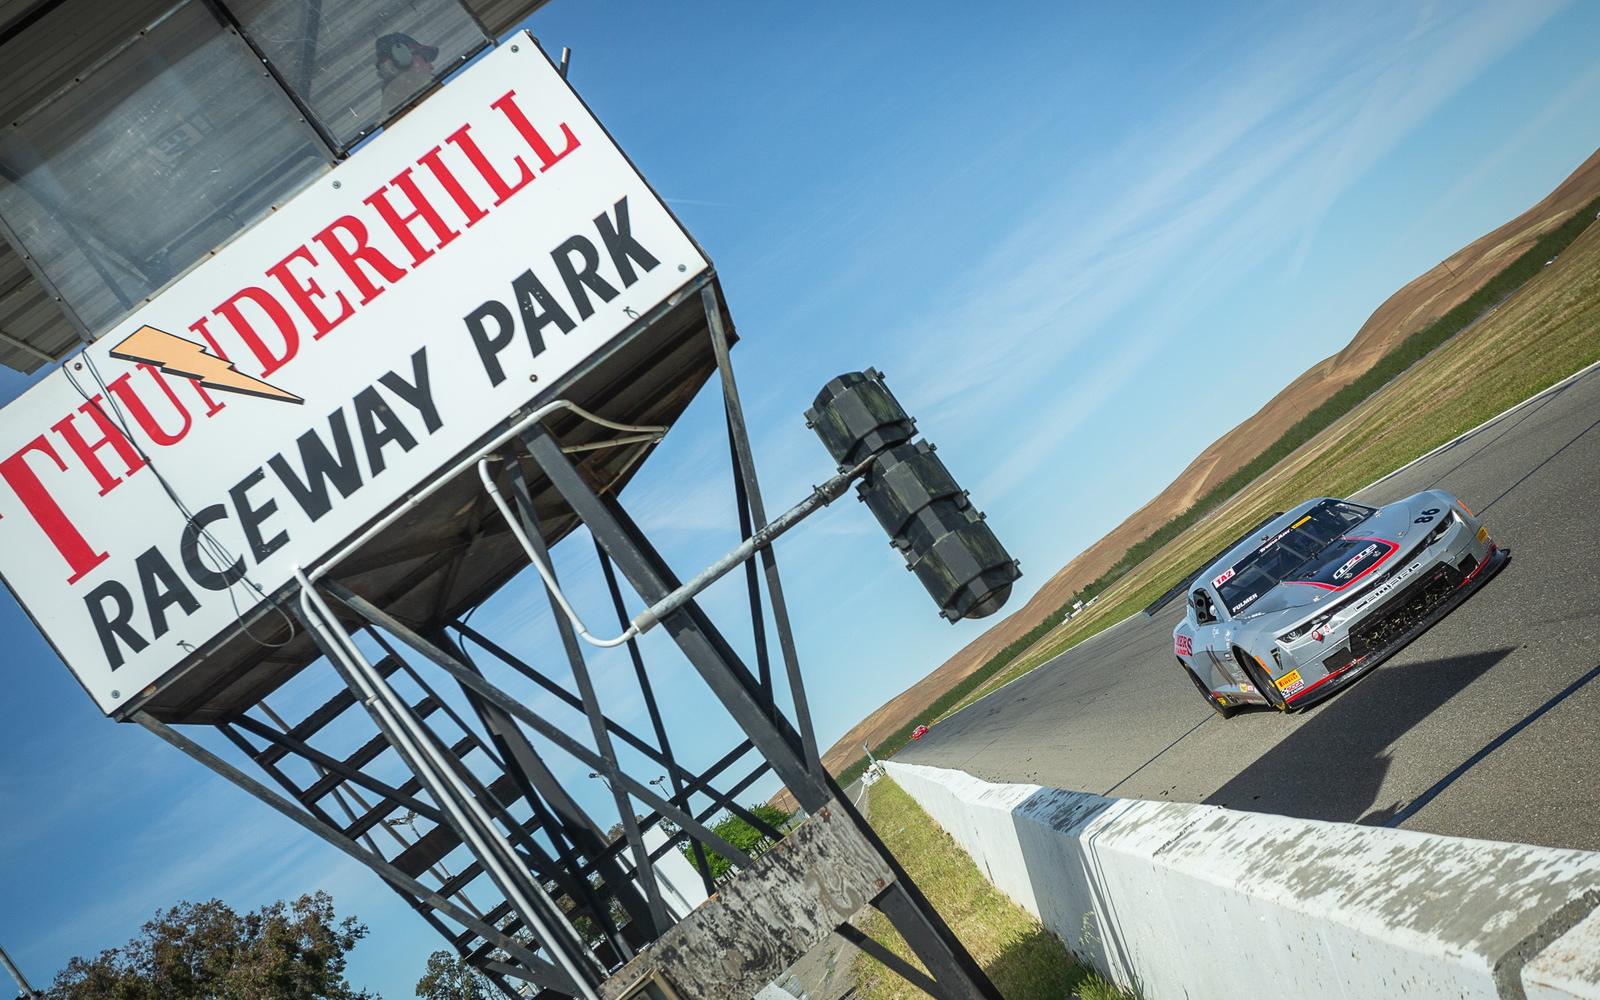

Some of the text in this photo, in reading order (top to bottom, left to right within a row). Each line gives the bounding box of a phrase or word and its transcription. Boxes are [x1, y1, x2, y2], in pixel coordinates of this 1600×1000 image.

[83, 195, 661, 672] RACEWAY PARK
[1414, 508, 1440, 524] 86
[1216, 570, 1234, 586] TA2
[1232, 593, 1258, 613] FULMER
